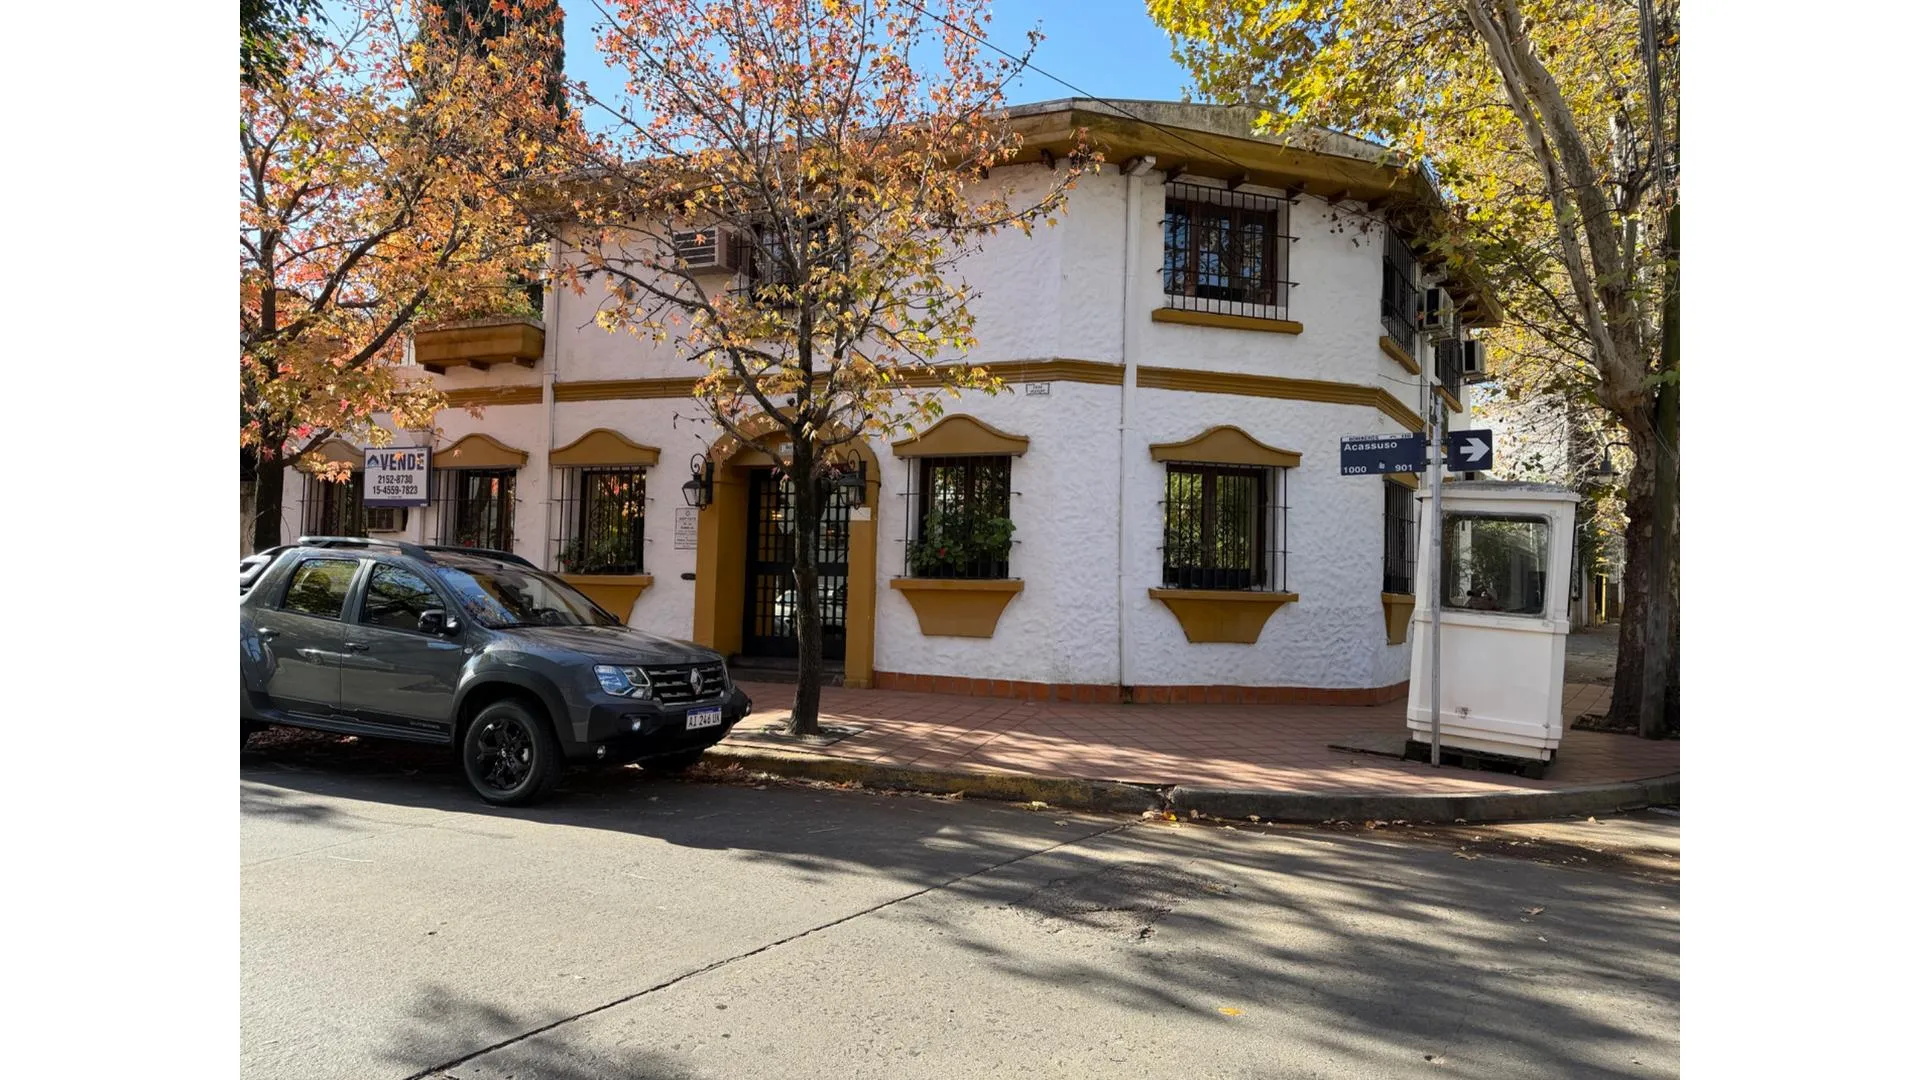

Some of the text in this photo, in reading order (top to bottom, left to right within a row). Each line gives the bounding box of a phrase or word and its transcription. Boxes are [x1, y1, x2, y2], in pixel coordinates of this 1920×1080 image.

[1343, 441, 1398, 451] Acassuso
[380, 453, 425, 471] VENDE
[1395, 464, 1413, 472] 901
